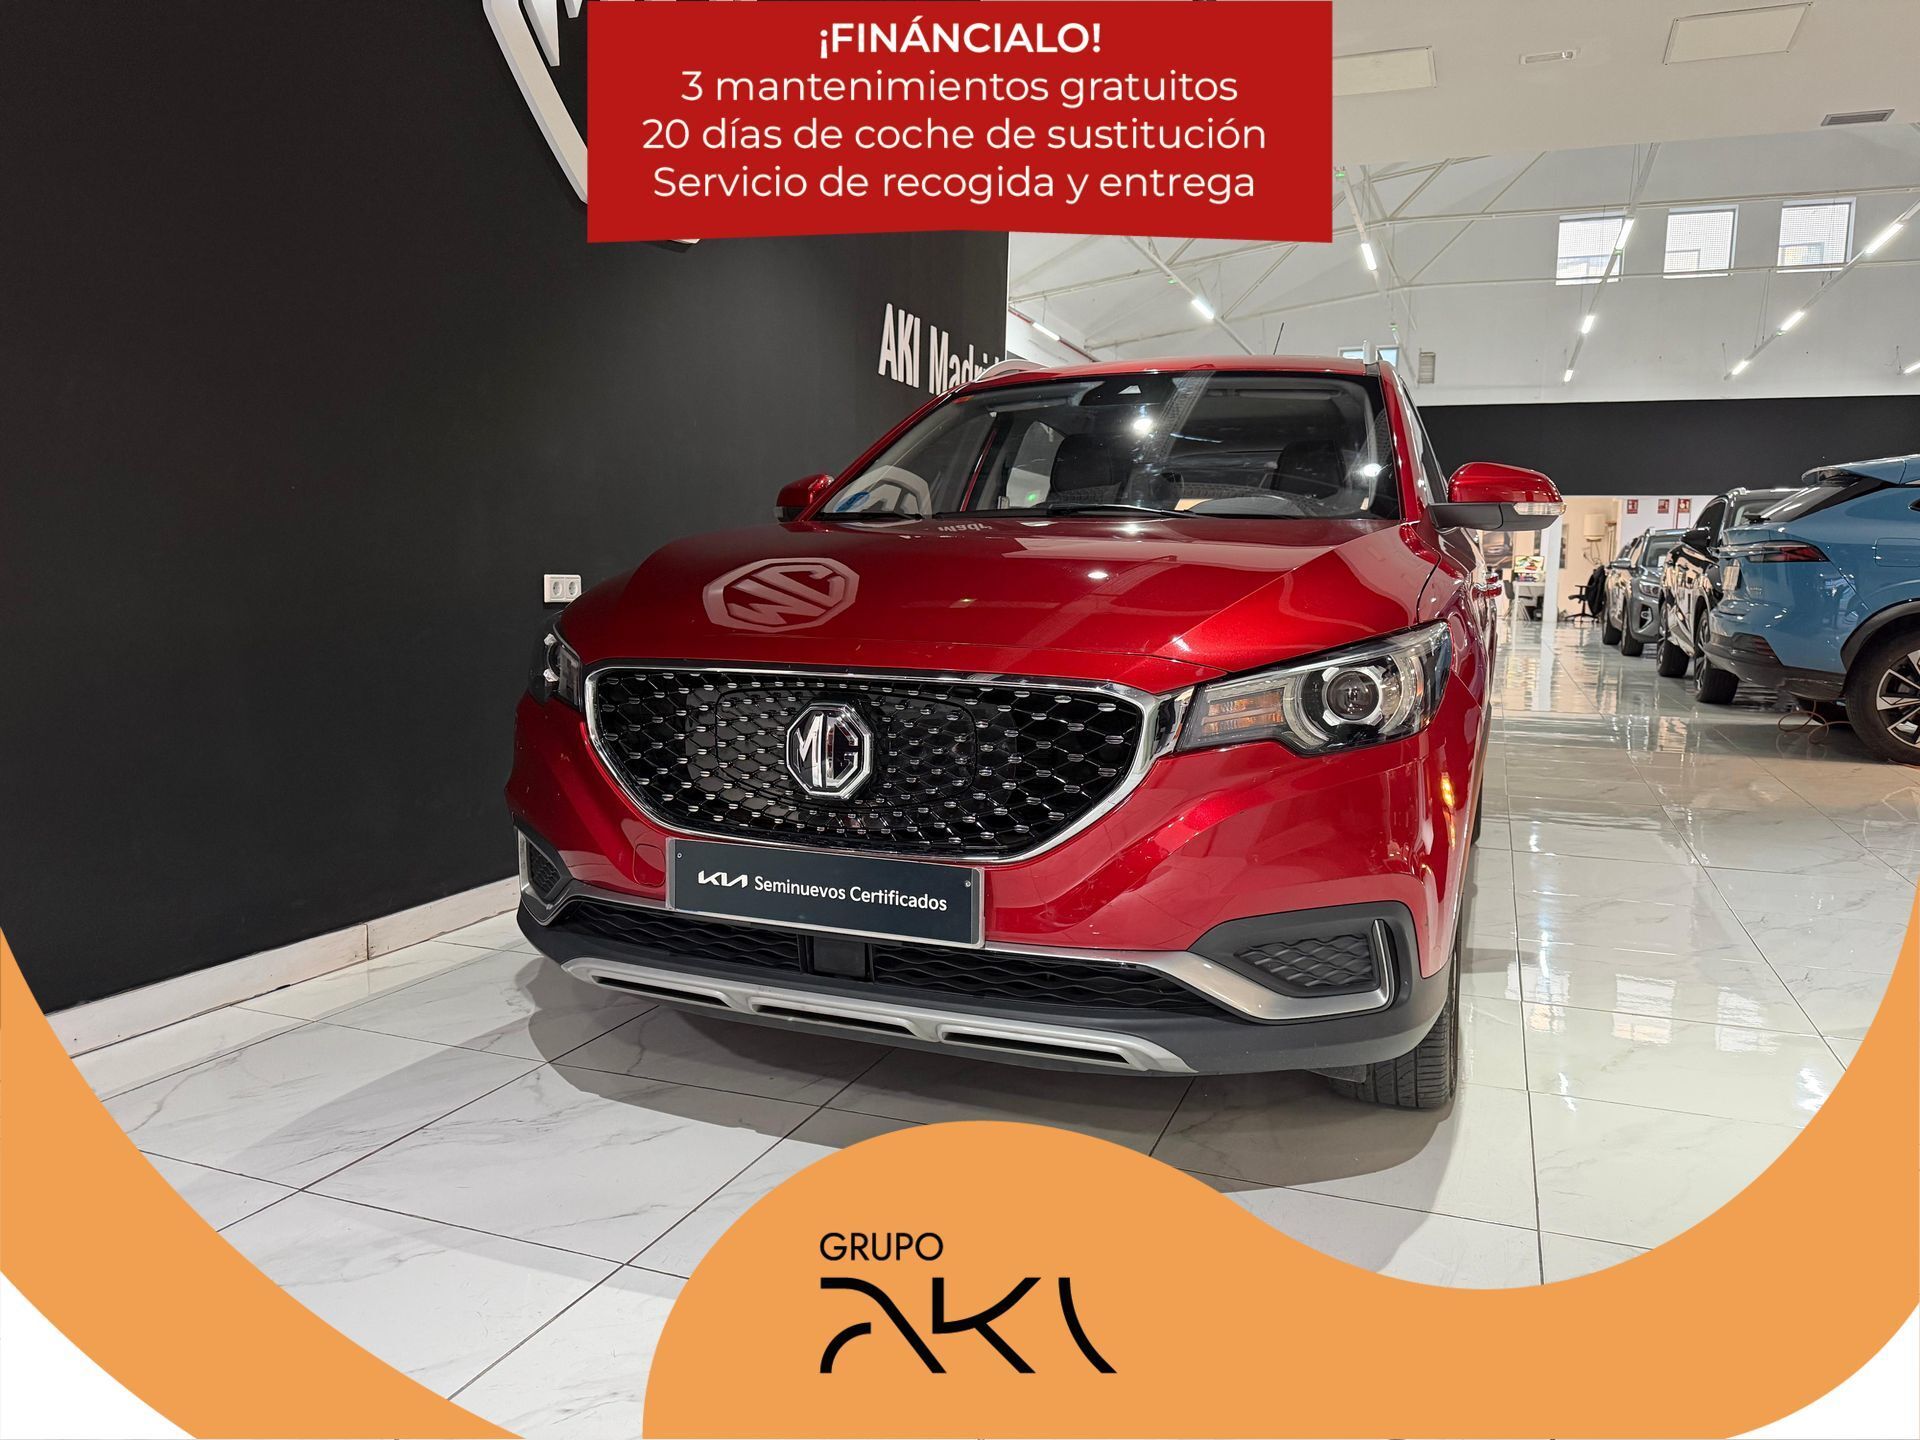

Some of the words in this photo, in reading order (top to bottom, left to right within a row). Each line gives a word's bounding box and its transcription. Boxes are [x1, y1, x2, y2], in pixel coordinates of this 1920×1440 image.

[878, 303, 921, 389] AKI
[796, 711, 860, 790] MG
[754, 875, 846, 900] Seminuevos
[849, 886, 948, 912] Certificados
